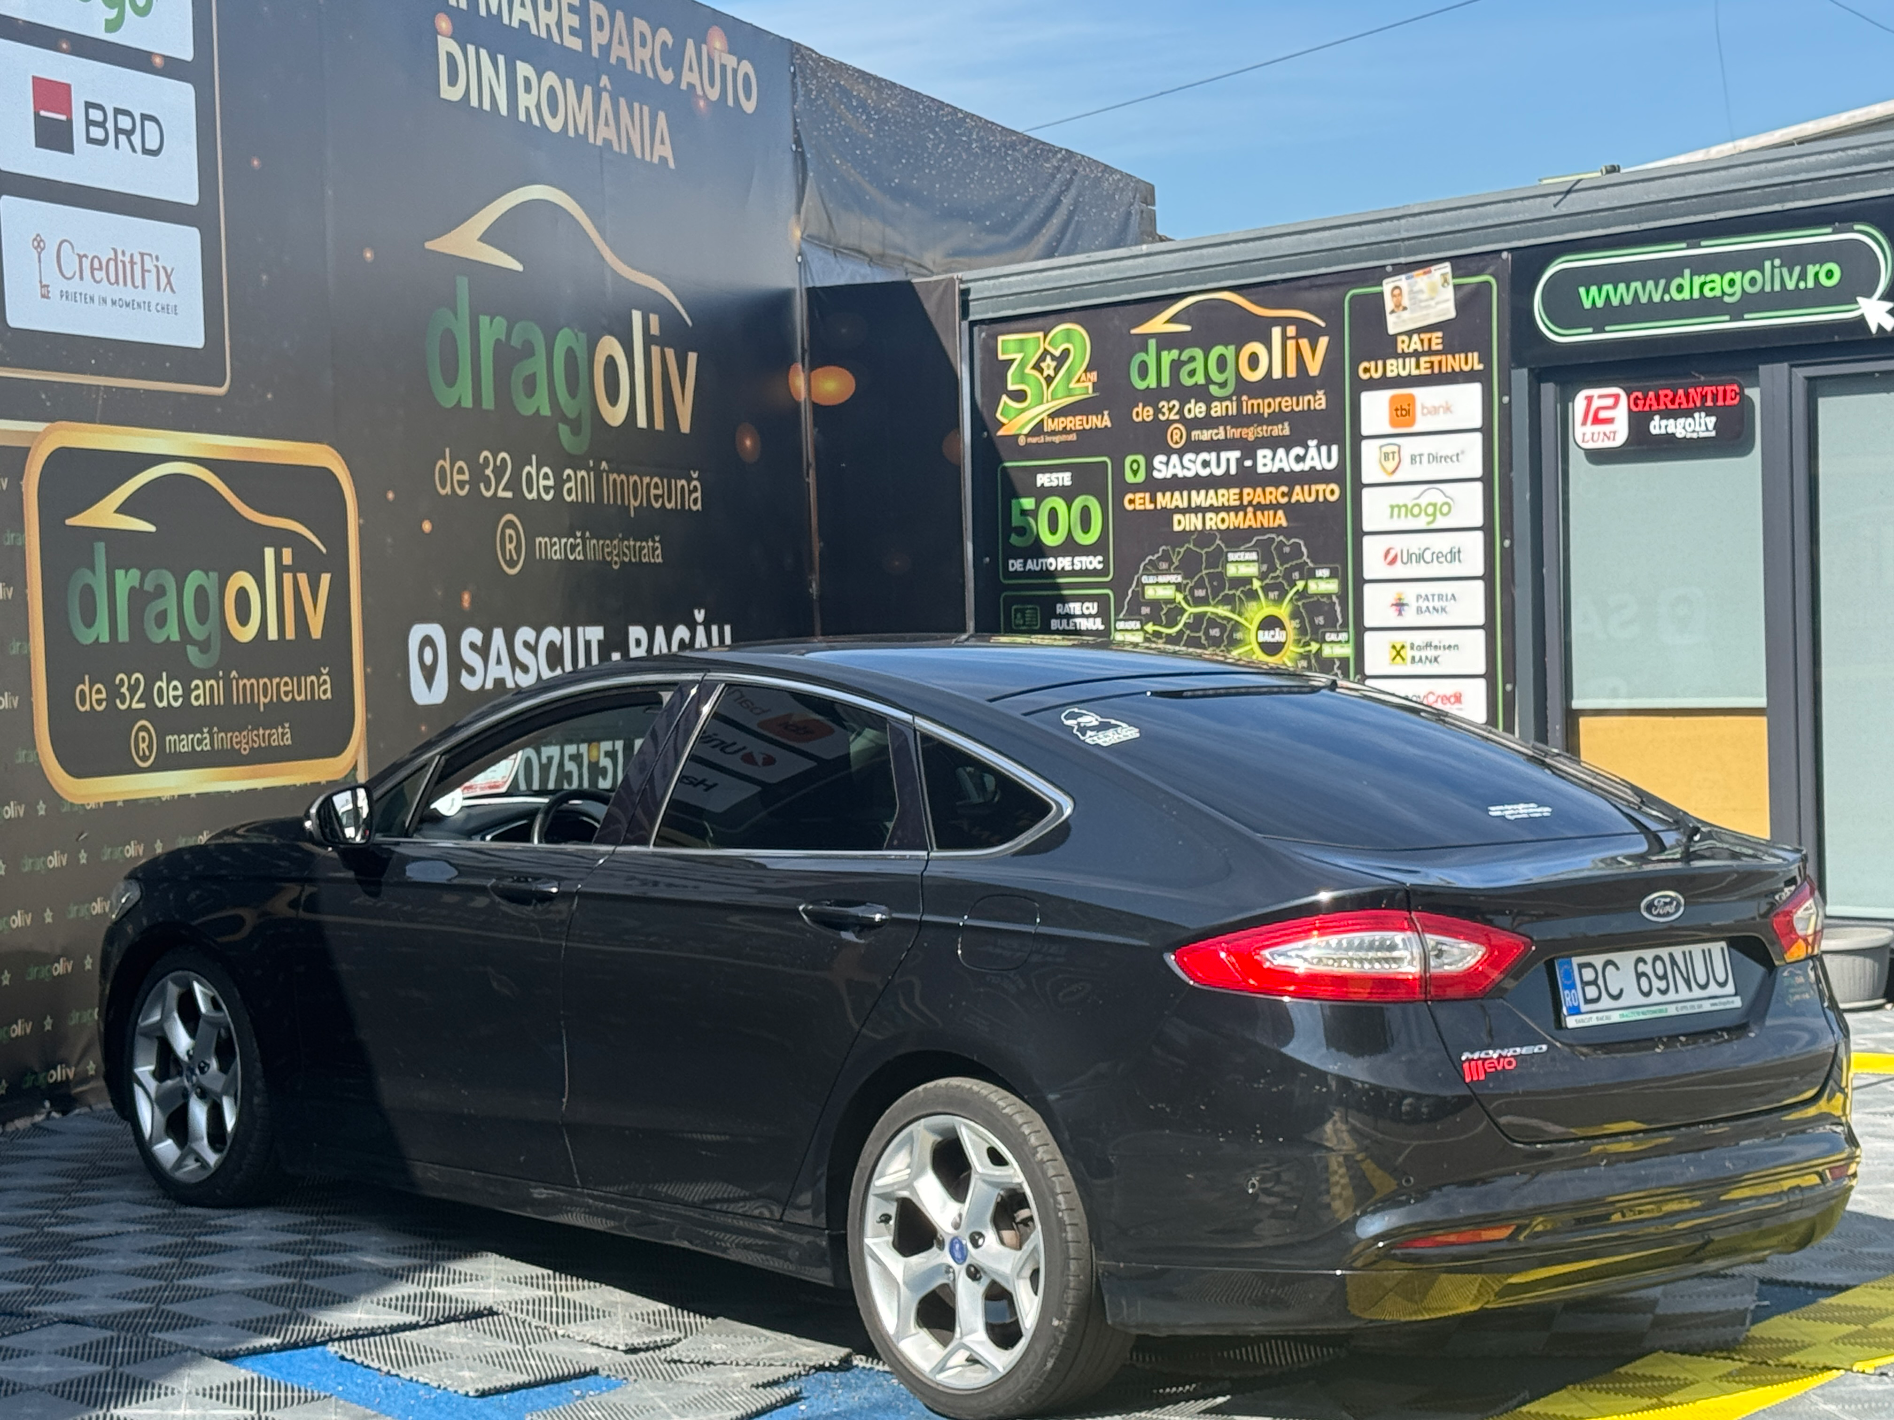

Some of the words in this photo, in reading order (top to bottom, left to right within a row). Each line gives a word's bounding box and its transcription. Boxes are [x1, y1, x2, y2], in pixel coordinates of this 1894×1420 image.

[589, 0, 675, 85] PARC
[680, 38, 757, 114] AUTO
[437, 35, 508, 117] DIN
[515, 60, 675, 169] ROMÂNIA
[84, 100, 165, 157] BRD
[56, 238, 176, 294] CreditFix
[1578, 258, 1841, 310] www.dragoliv.ro
[60, 289, 95, 305] PRIETEN
[98, 295, 107, 307] IN
[111, 297, 152, 312] MOMENTE
[155, 302, 178, 316] CHEIE
[1396, 331, 1444, 354] RATE
[426, 275, 697, 455] dragoliv
[995, 323, 1092, 425] 32
[1129, 325, 1330, 397] dragoliv
[1357, 360, 1383, 380] CU
[1386, 351, 1484, 378] BULETINUL
[1080, 371, 1097, 382] ANI
[1132, 403, 1154, 423] de
[1157, 400, 1181, 421] 32
[1184, 398, 1206, 419] de
[1210, 396, 1237, 417] ani
[1241, 390, 1326, 418] împreună
[1394, 403, 1411, 418] tbi
[1421, 402, 1453, 417] bank
[1581, 393, 1621, 427] 12
[1629, 384, 1740, 412] GARANTIE
[1043, 410, 1112, 432] ÎMPREUNĂ
[1191, 425, 1225, 442] marcă
[1226, 422, 1290, 441] înregistrată
[1649, 411, 1717, 439] dragoliv
[1581, 430, 1617, 444] LUNI
[1152, 450, 1241, 480] SASCUT
[1256, 440, 1339, 474] BACĂU
[1410, 453, 1425, 466] BT
[434, 448, 470, 496] de
[479, 450, 513, 499] 32
[522, 455, 555, 501] de
[563, 459, 595, 503] ani
[601, 461, 702, 517] împreună
[1036, 472, 1073, 489] PESTE
[1123, 492, 1154, 511] CEL
[1157, 490, 1188, 509] MAI
[1191, 488, 1241, 507] MARE
[1242, 486, 1291, 506] PARC
[1292, 483, 1340, 503] AUTO
[1009, 494, 1103, 548] 500
[1173, 513, 1204, 532] DIN
[1205, 508, 1287, 531] ROMÂNIA
[1389, 501, 1452, 526] mogo
[535, 530, 584, 562] marcă
[586, 531, 663, 570] înregistrată
[1008, 558, 1023, 572] DE
[1025, 557, 1056, 571] AUTO
[1057, 556, 1072, 571] PE
[1073, 555, 1103, 570] STOC
[1400, 547, 1463, 566] UniCredit
[67, 542, 332, 669] dragoliv
[1056, 602, 1082, 615] RATE
[1083, 601, 1098, 615] CU
[1416, 593, 1457, 604] PATRIA
[1416, 605, 1448, 616] BANK
[1050, 617, 1105, 630] BULETINUL
[460, 625, 604, 691] SASCUT
[1410, 641, 1459, 652] Raiffeisen
[1410, 655, 1440, 665] BANK
[75, 675, 107, 712] de
[115, 673, 146, 711] 32
[153, 671, 184, 708] de
[190, 671, 224, 707] ani
[231, 667, 332, 712] împreună
[165, 725, 211, 754] marcă
[213, 722, 292, 755] înregistrată
[1577, 959, 1624, 1006] BC
[1634, 946, 1729, 998] 69NUU
[1564, 990, 1578, 1007] RO
[1461, 1044, 1548, 1061] MONDEO
